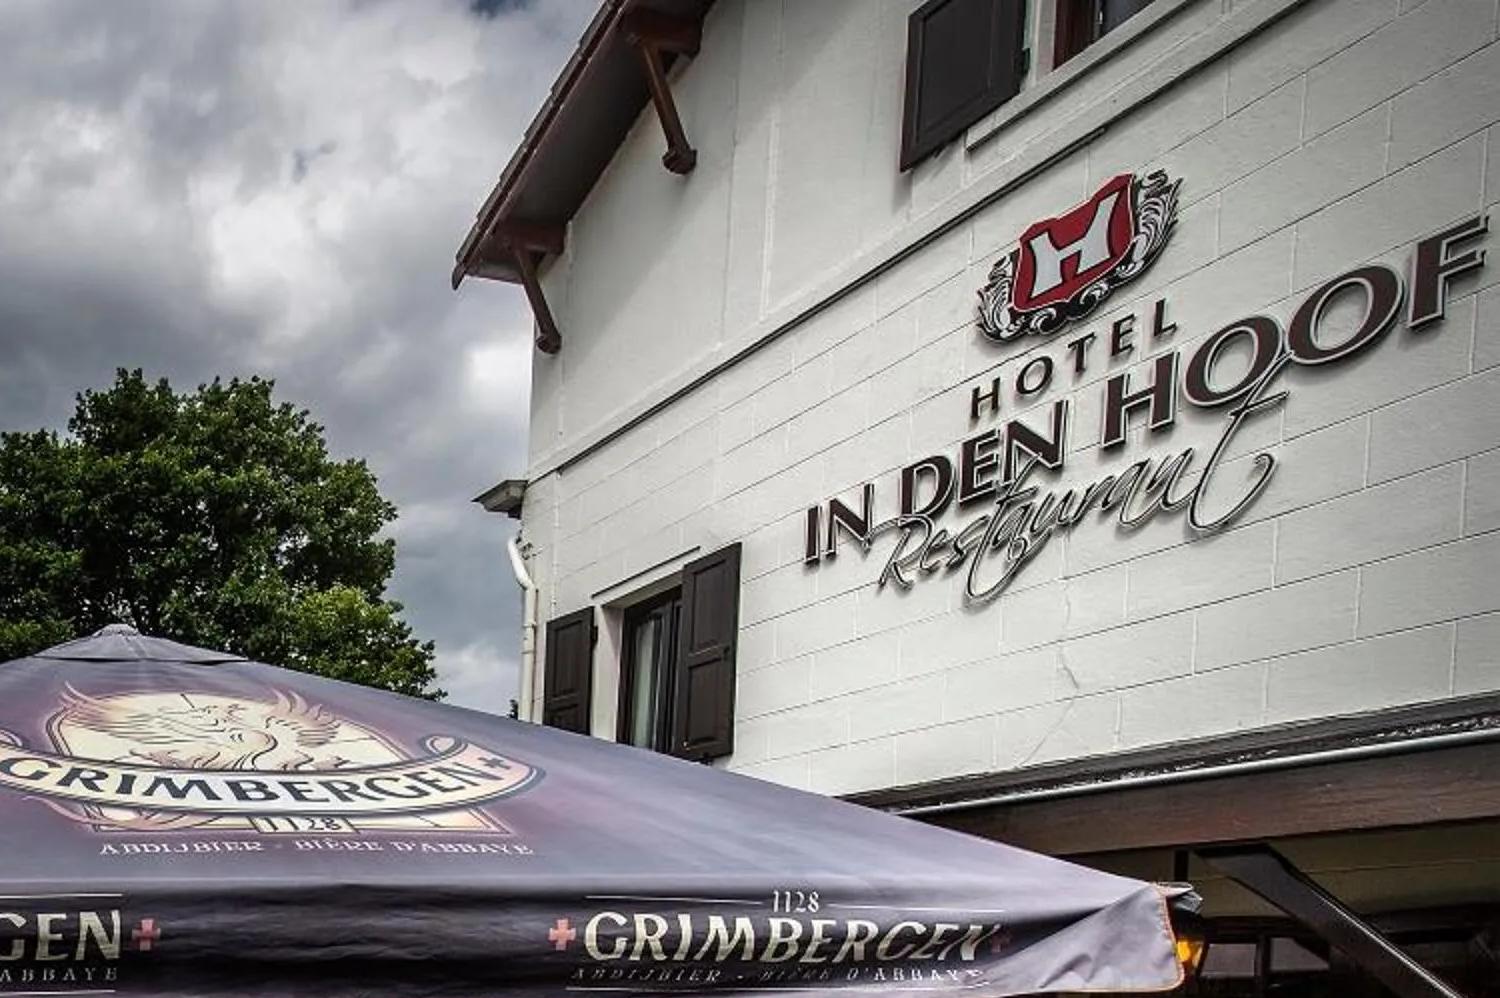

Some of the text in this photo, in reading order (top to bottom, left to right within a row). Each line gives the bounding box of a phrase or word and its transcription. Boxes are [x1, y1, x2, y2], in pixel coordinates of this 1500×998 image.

[1027, 188, 1124, 298] H
[804, 214, 1489, 566] IN DEN HOOF
[970, 299, 1178, 420] HOTEL
[100, 841, 263, 855] ABDIJBIER
[262, 816, 342, 832] 1128
[773, 891, 820, 913] 1128
